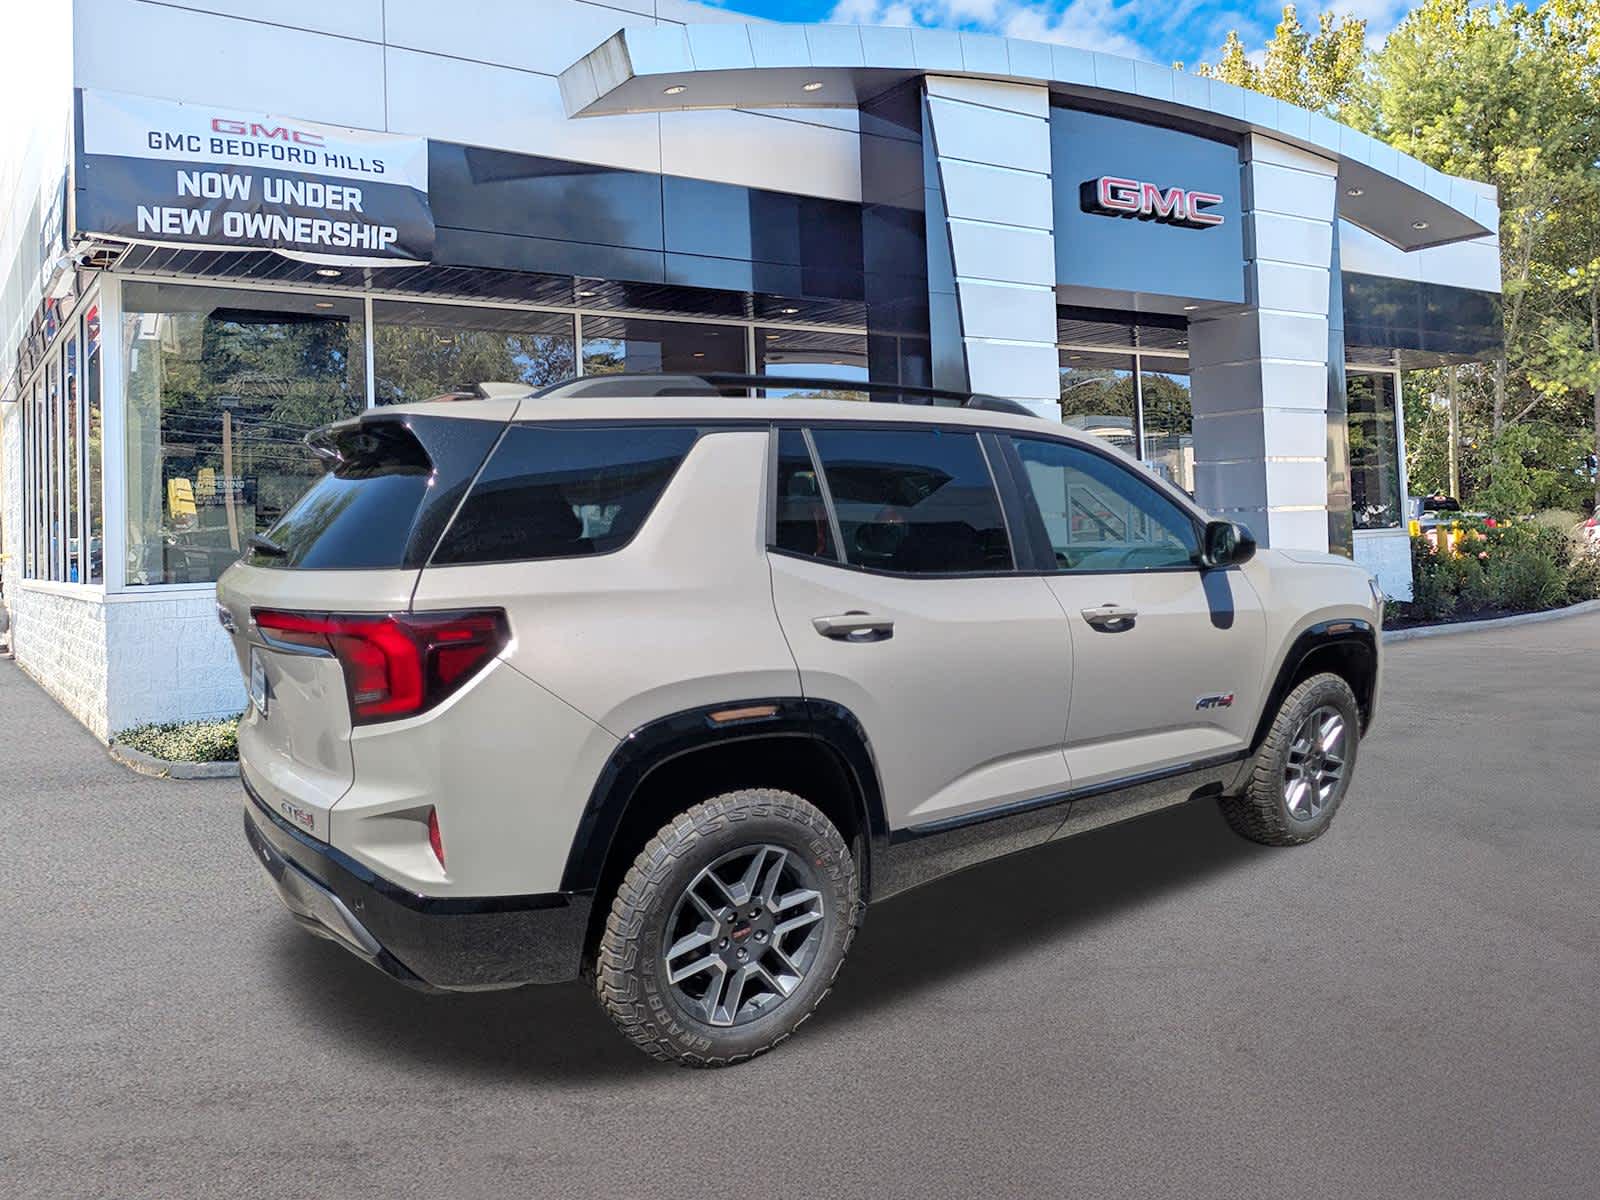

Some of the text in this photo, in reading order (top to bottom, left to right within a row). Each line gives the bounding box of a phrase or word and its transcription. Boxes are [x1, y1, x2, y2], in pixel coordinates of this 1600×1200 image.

[148, 131, 385, 174] GMC BEDFORD HILLS
[210, 118, 326, 148] GMC
[177, 170, 364, 213] NOW UNDER
[1097, 175, 1225, 225] GMC
[136, 205, 398, 250] NEW OWNERSHIP
